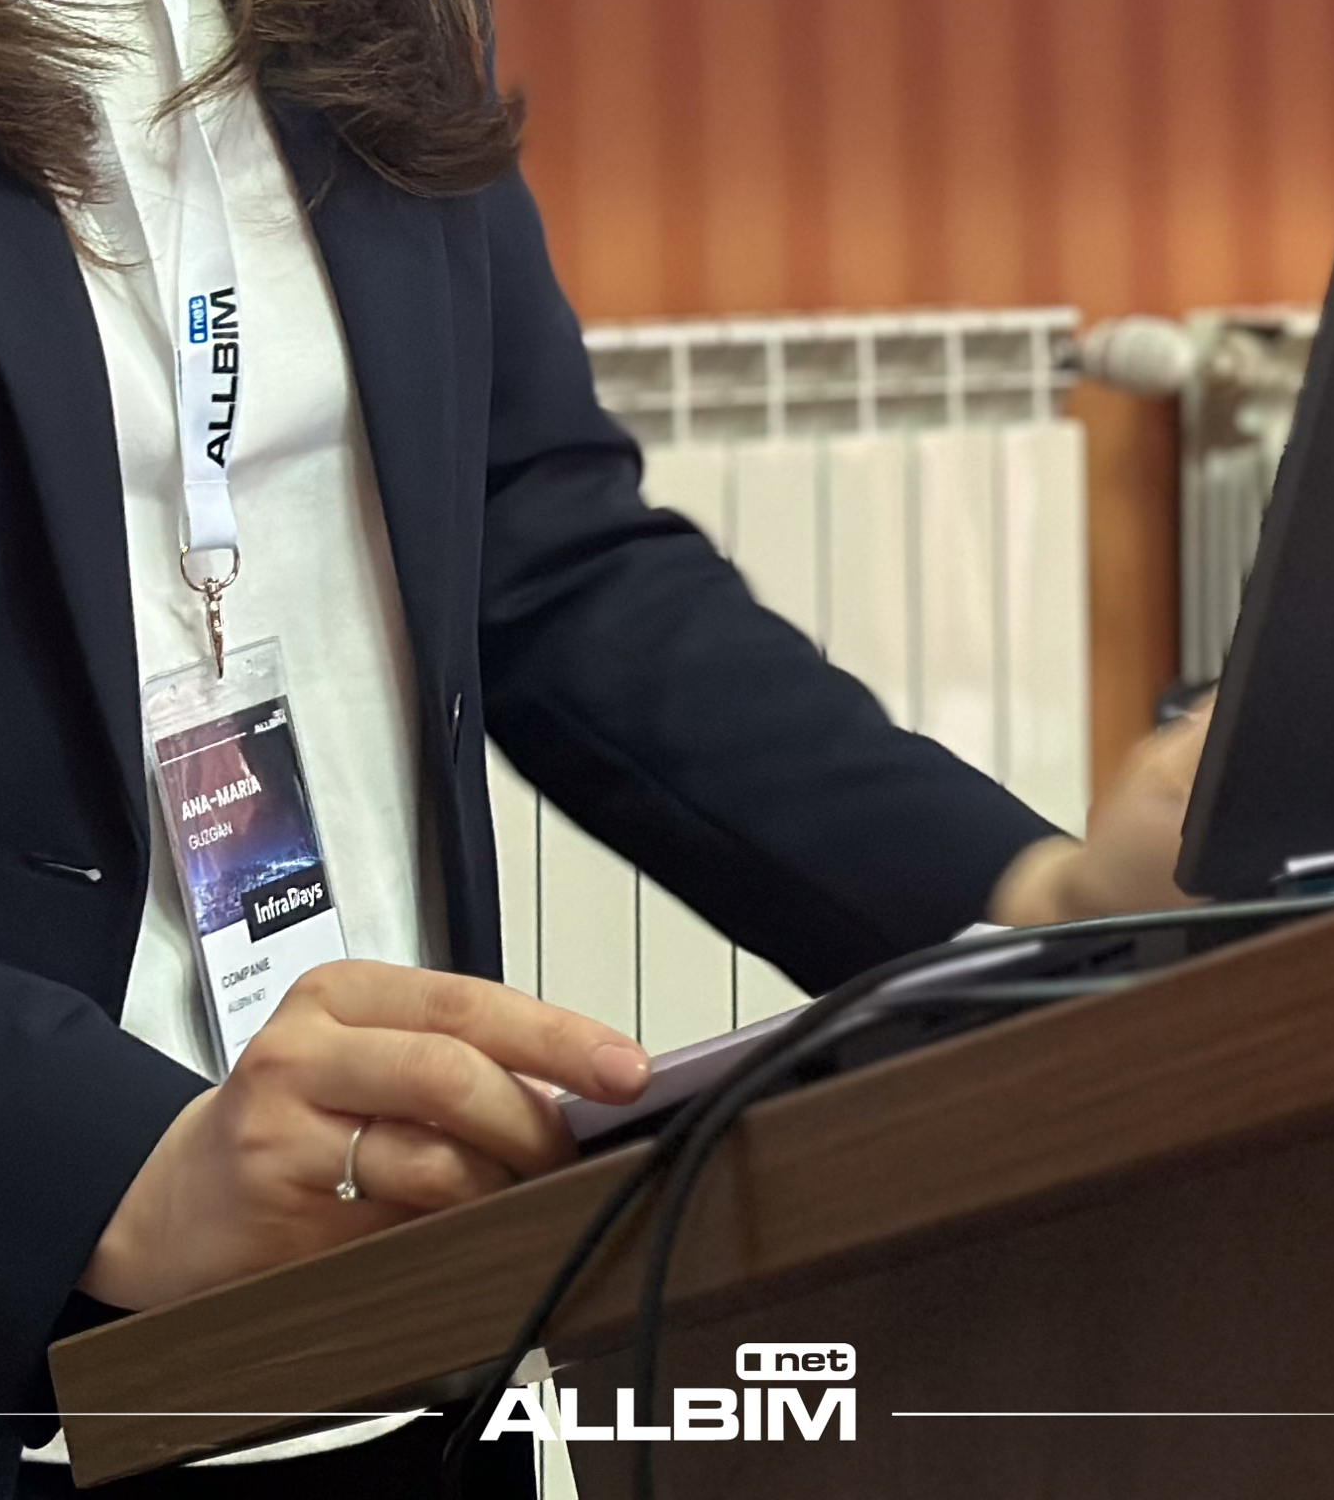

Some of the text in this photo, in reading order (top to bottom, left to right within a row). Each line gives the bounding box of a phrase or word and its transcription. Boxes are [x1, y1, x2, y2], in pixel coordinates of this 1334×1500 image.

[192, 297, 205, 332] net
[206, 286, 240, 468] ALLBIM
[182, 774, 262, 821] ANA-MARIA
[253, 882, 324, 924] InfraDays
